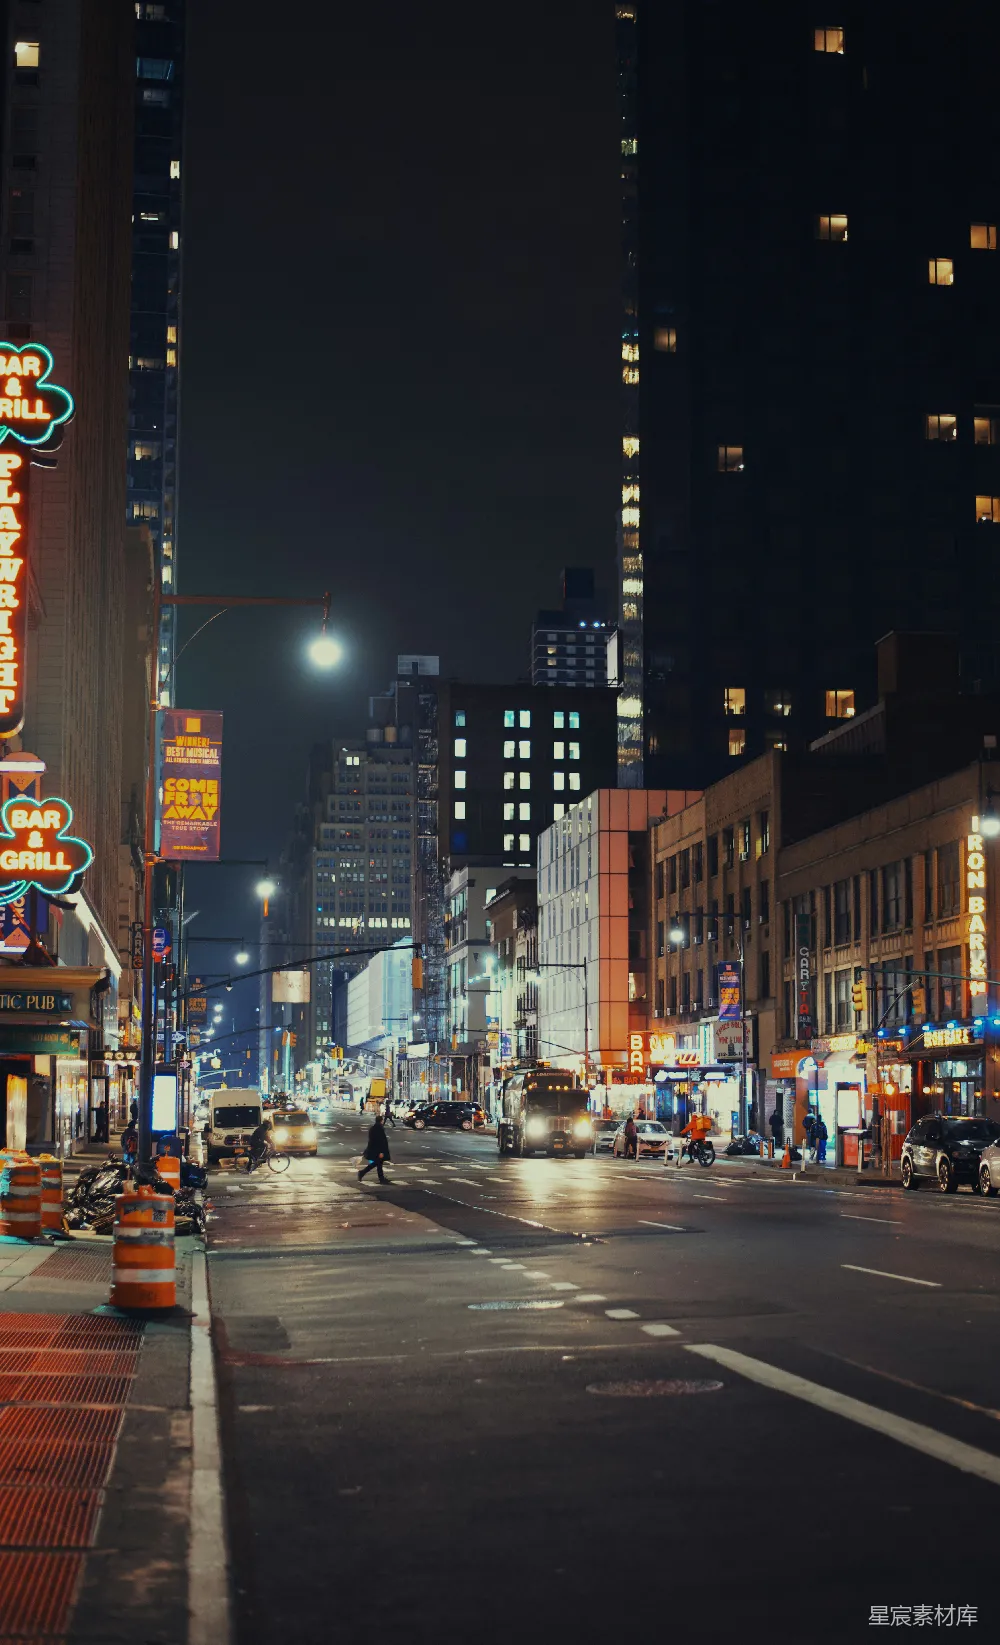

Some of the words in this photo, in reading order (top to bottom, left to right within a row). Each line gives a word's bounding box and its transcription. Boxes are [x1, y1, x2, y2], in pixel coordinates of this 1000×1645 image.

[5, 377, 22, 397] &
[0, 453, 24, 714] PLAYWRIGHT
[166, 746, 185, 757] BEST
[186, 747, 219, 759] MUSICAL
[165, 778, 219, 793] COME
[11, 810, 60, 829] BAR
[163, 805, 219, 820] AWAY
[28, 830, 44, 849] &
[0, 851, 72, 871] GRILL
[967, 815, 985, 888] IRON
[968, 896, 986, 950] BAR
[26, 995, 55, 1010] PUB
[104, 1051, 137, 1060] ROW
